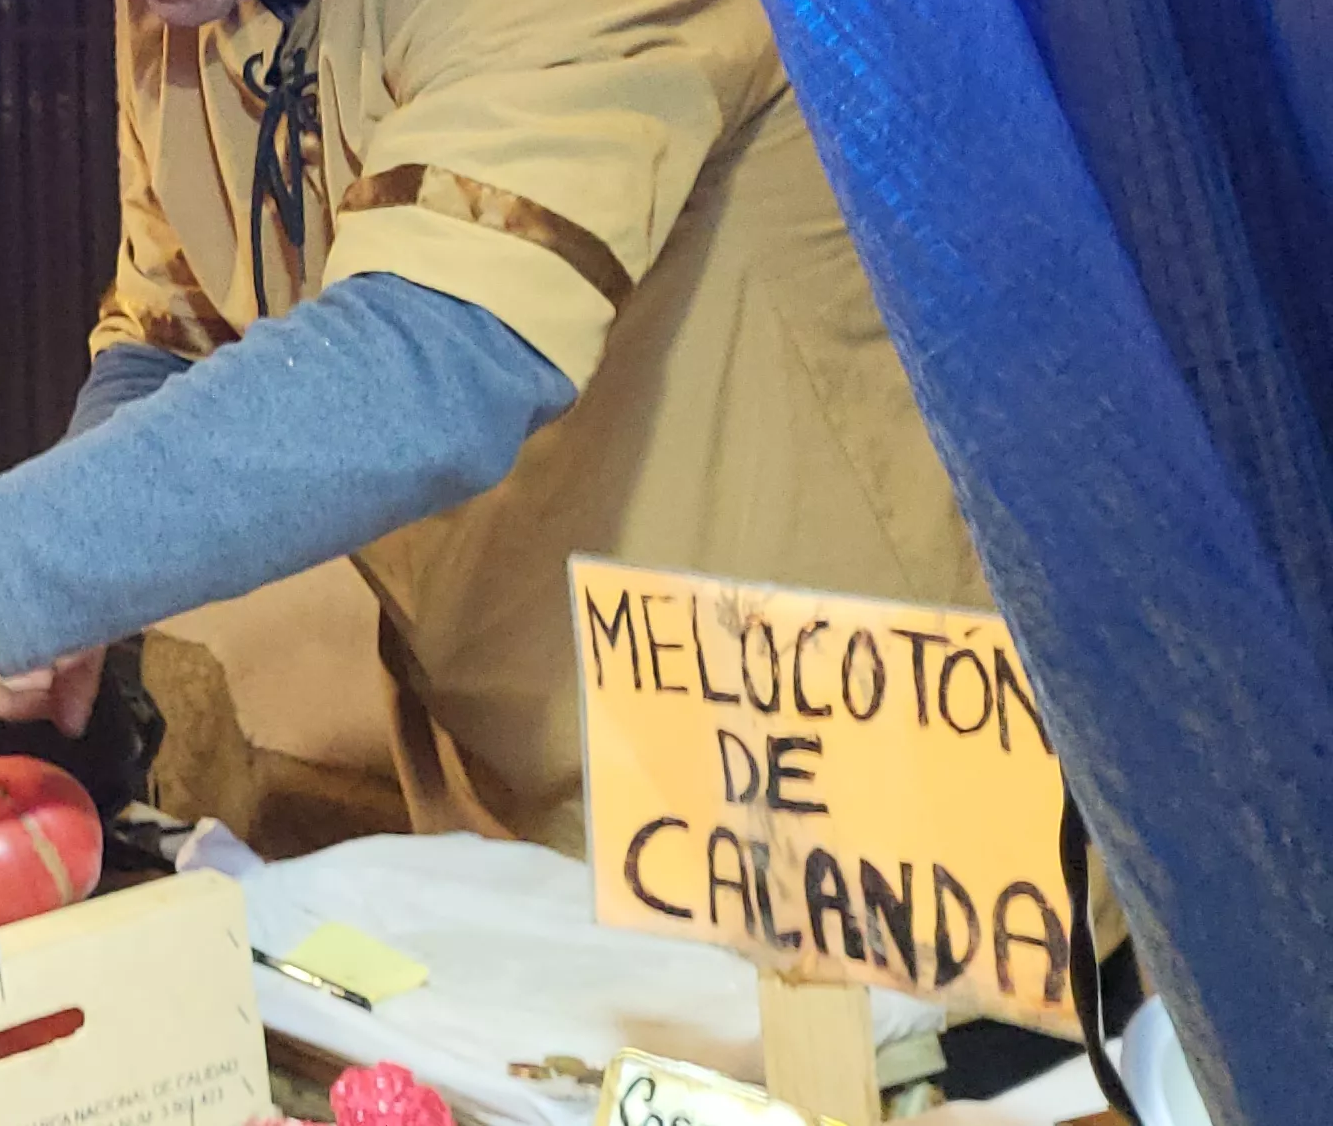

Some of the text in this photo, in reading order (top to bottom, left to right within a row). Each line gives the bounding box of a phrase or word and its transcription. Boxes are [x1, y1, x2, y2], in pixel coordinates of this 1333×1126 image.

[585, 585, 1060, 754] MELOCOTÓN
[717, 728, 829, 814] DE
[624, 816, 1069, 1003] CALANDA
[175, 1057, 239, 1088] CALIDAD
